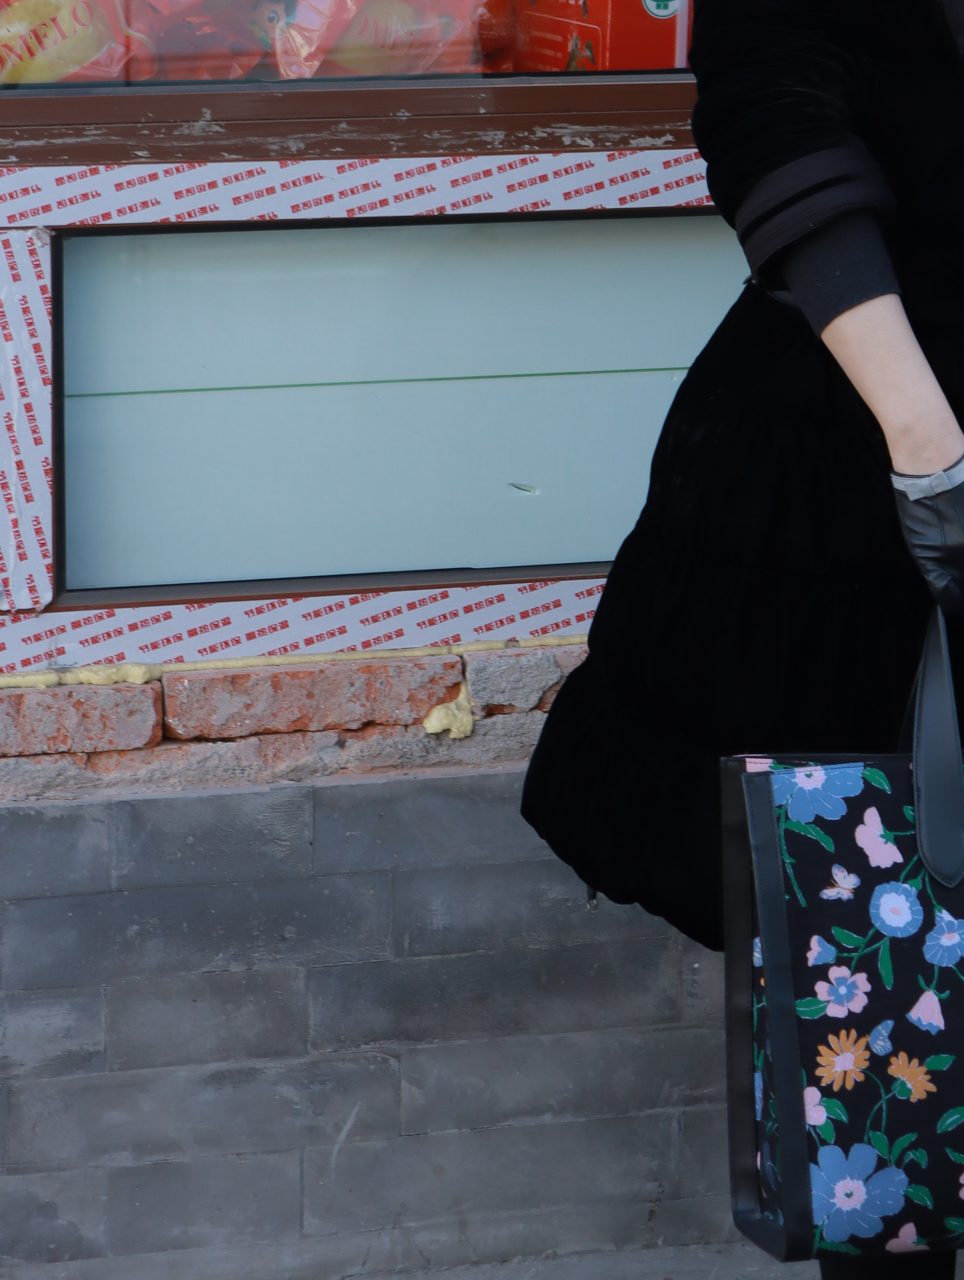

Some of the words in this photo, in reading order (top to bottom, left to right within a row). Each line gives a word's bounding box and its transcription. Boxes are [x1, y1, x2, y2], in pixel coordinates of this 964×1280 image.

[0, 0, 94, 73] MELO
[1, 239, 21, 282] 隔热保温
[20, 296, 38, 339] 节能环保
[12, 356, 30, 399] 节能环保
[23, 402, 43, 446] 隔热保温
[4, 413, 20, 456] 节能环保
[14, 459, 34, 503] 隔热保温
[10, 517, 28, 561] 隔热保温
[33, 516, 50, 560] 节能环保
